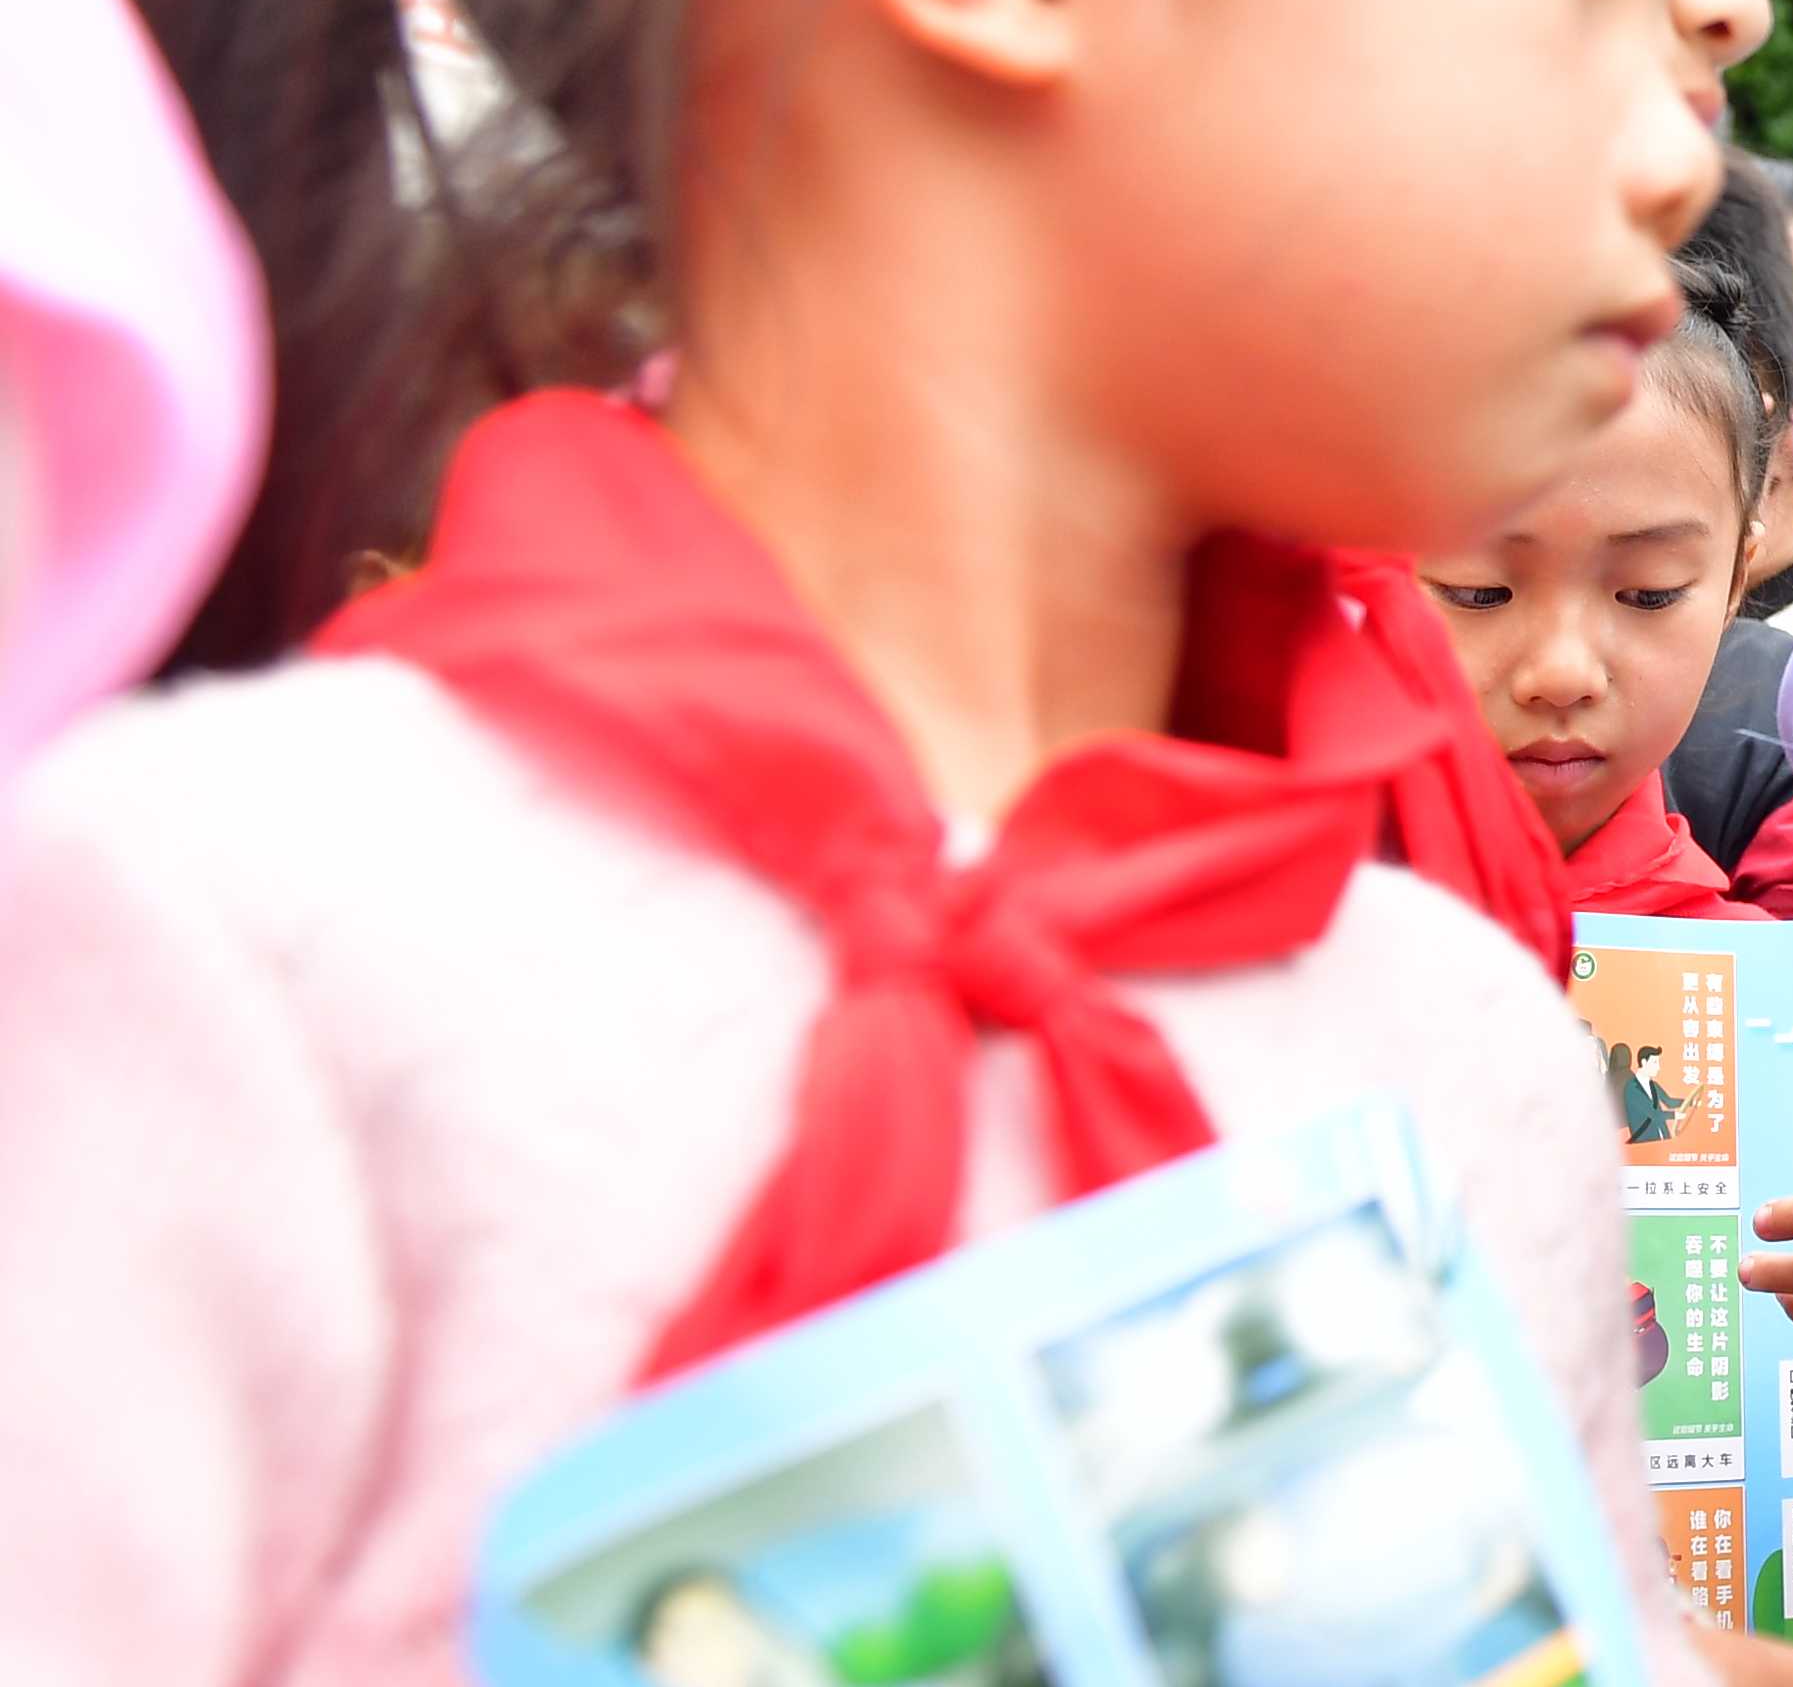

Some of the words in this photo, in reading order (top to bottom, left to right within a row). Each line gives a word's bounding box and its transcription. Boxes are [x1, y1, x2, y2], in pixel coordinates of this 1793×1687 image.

[1685, 1235, 1704, 1376] 吞噬你的生命
[1709, 1235, 1729, 1400] 不要让这片阴影
[1650, 1452, 1733, 1469] 区远离大车
[1714, 1508, 1734, 1630] 你在看手机
